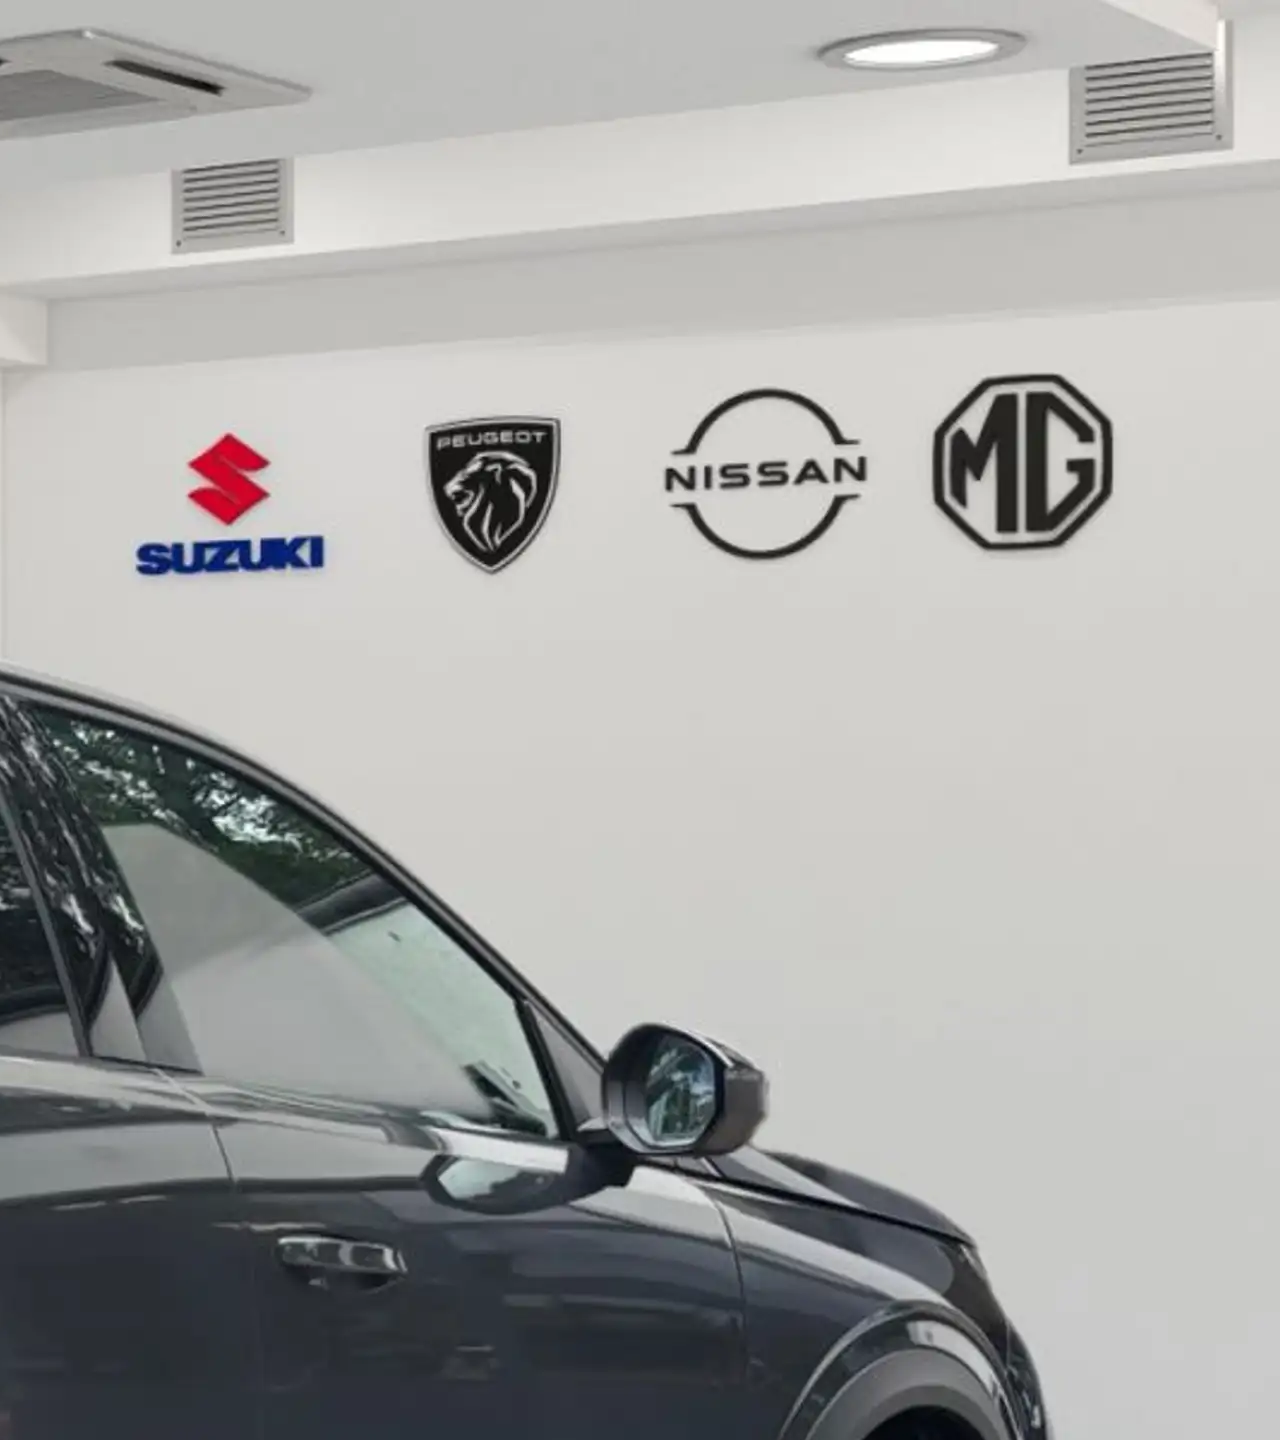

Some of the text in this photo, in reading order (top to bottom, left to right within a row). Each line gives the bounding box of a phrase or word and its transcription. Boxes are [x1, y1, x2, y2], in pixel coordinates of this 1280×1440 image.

[437, 430, 548, 450] PEUGEOT
[664, 456, 867, 493] NISSAN
[950, 390, 1096, 534] MG
[136, 535, 325, 577] SUZUKI
